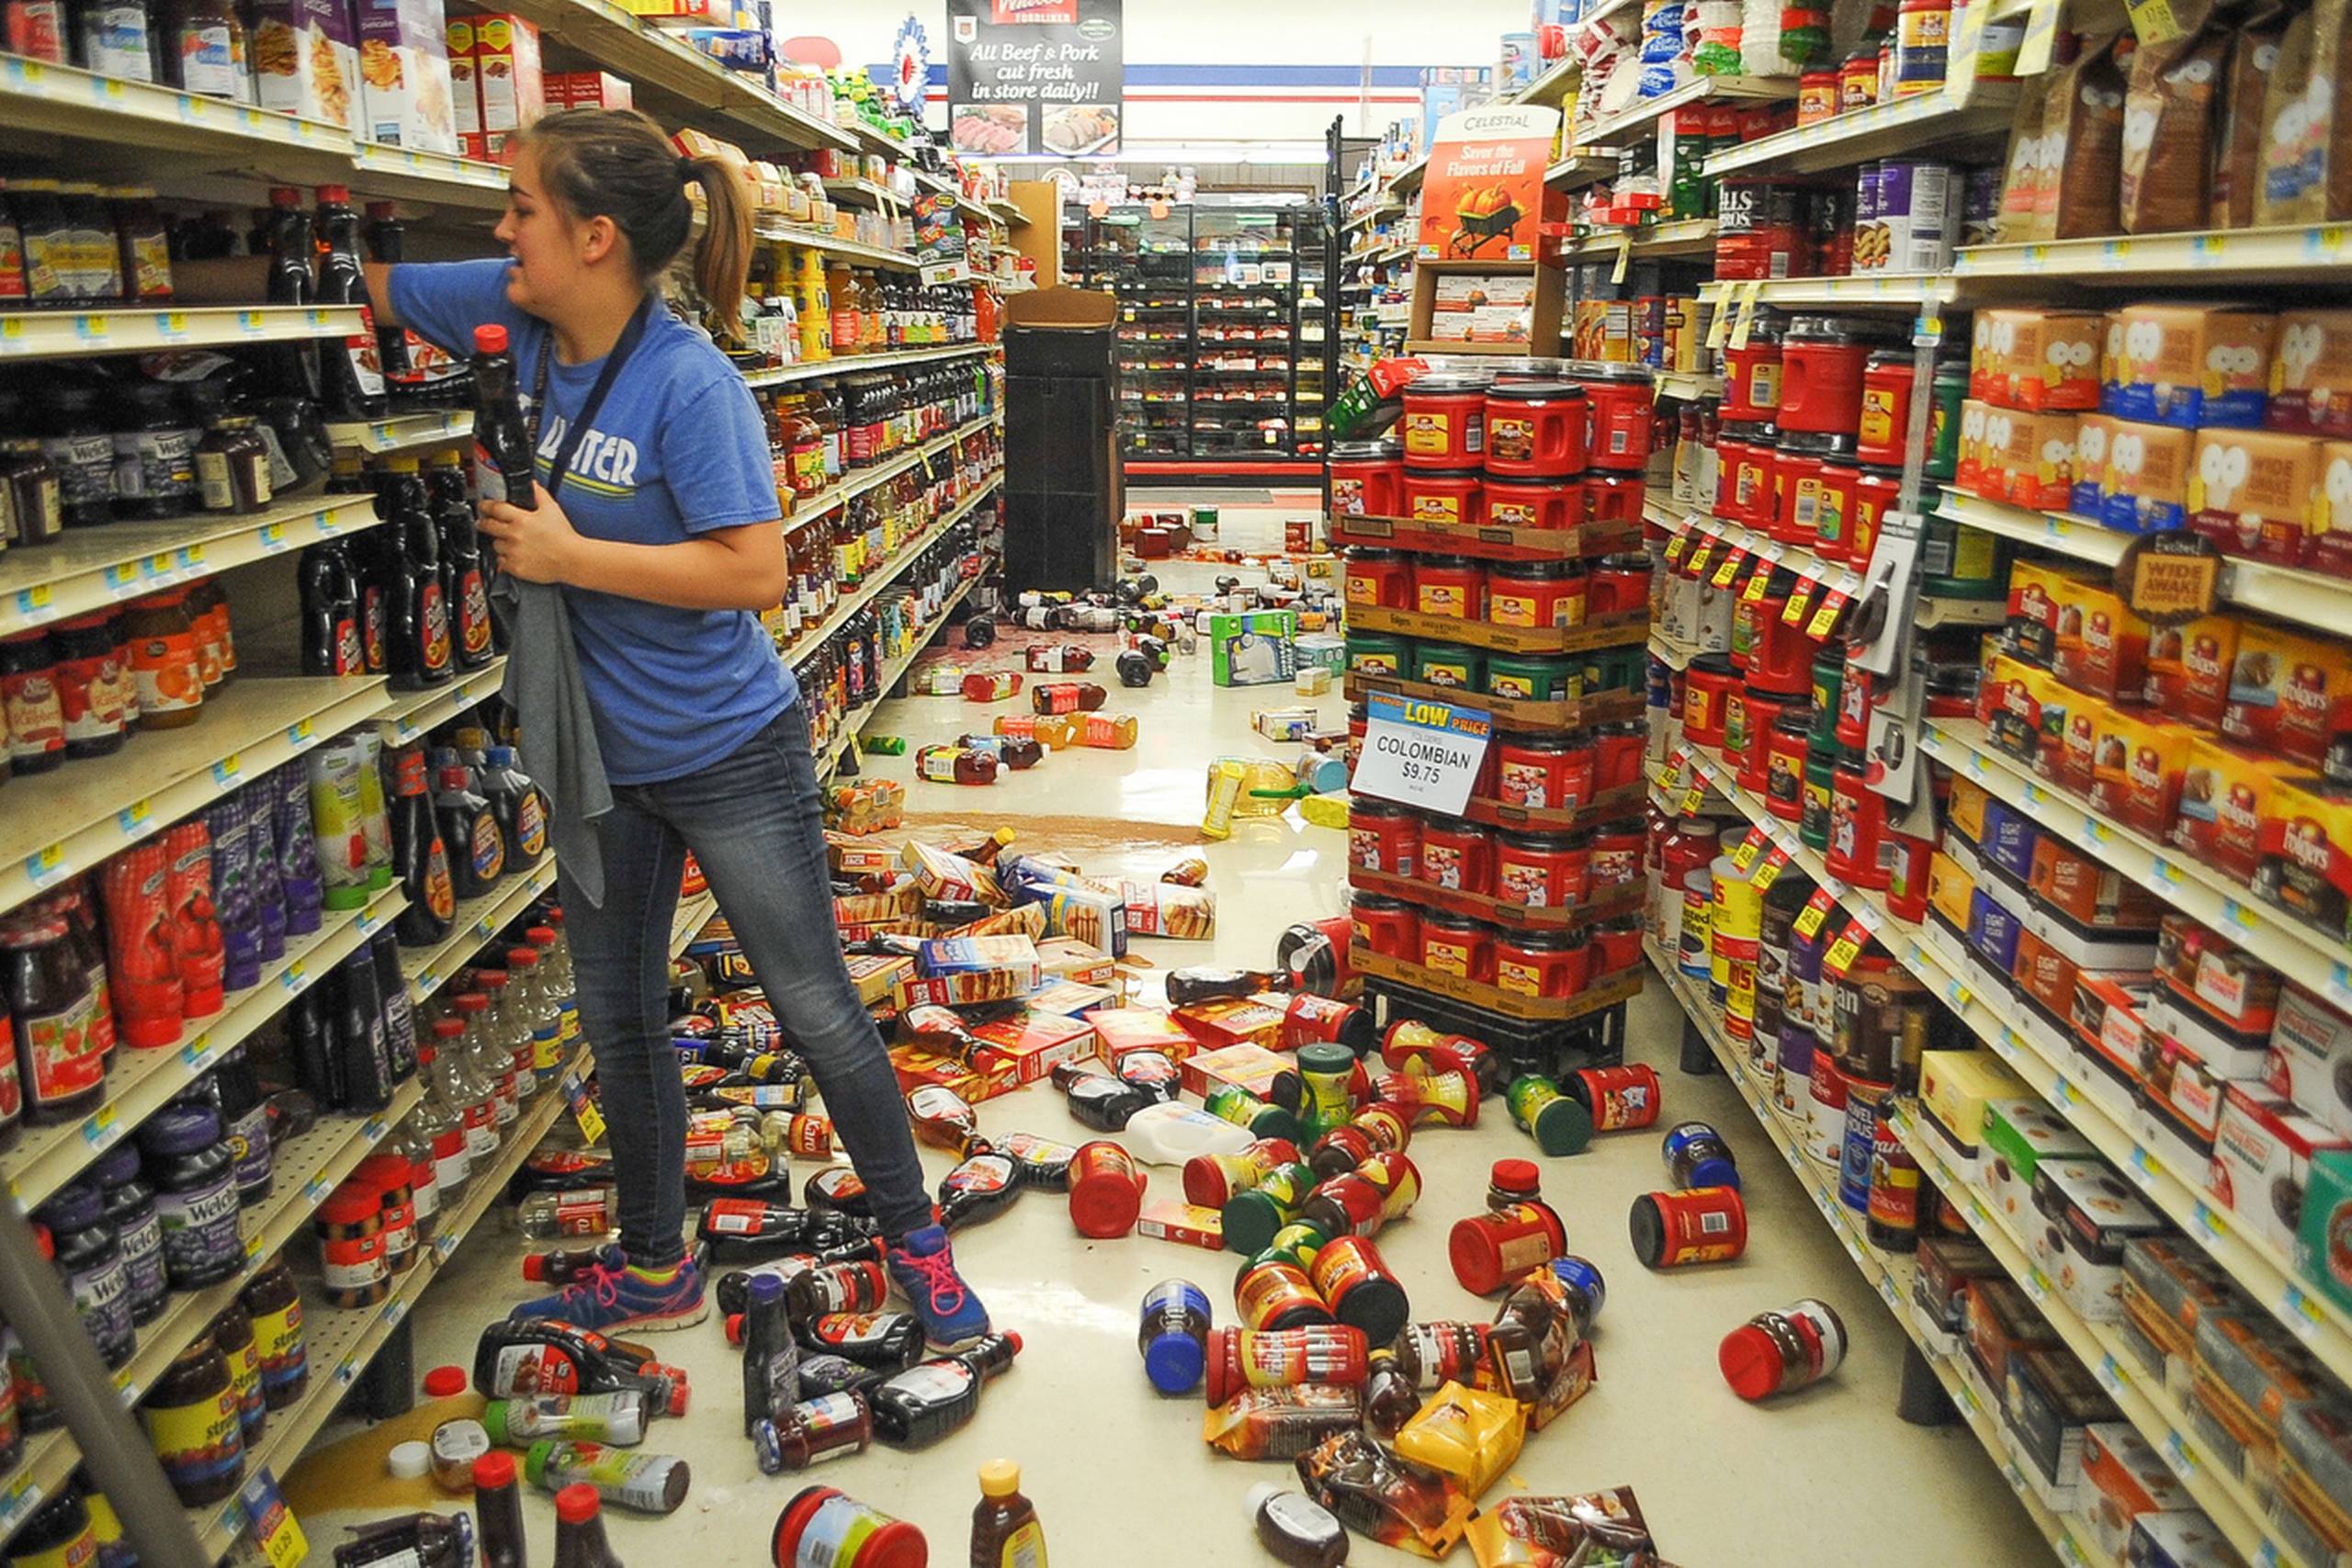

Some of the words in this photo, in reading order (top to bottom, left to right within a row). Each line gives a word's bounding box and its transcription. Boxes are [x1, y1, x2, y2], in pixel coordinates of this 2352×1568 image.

[969, 44, 997, 62] All
[1001, 44, 1043, 63] Beef
[1045, 48, 1056, 61] &
[1059, 45, 1100, 62] Pork
[997, 64, 1024, 80] cut
[1027, 63, 1074, 82] fresh
[972, 81, 990, 98] in
[993, 83, 1037, 99] store
[1040, 82, 1100, 102] daily!!
[1464, 115, 1529, 130] CELESTIAL
[1496, 144, 1515, 158] the
[1447, 163, 1487, 176] Flavors
[1489, 162, 1502, 175] of
[1503, 160, 1526, 175] Fall
[2147, 561, 2203, 579] WIDE
[2145, 578, 2201, 592] AWAKE
[2284, 675, 2328, 710] Folgers
[1404, 701, 1451, 728] LOW
[1452, 716, 1490, 737] PRICE
[1376, 735, 1472, 770] COLOMBIAN
[1402, 761, 1442, 784] $9.75
[2282, 820, 2331, 871] Folgers
[803, 1117, 821, 1153] Karo
